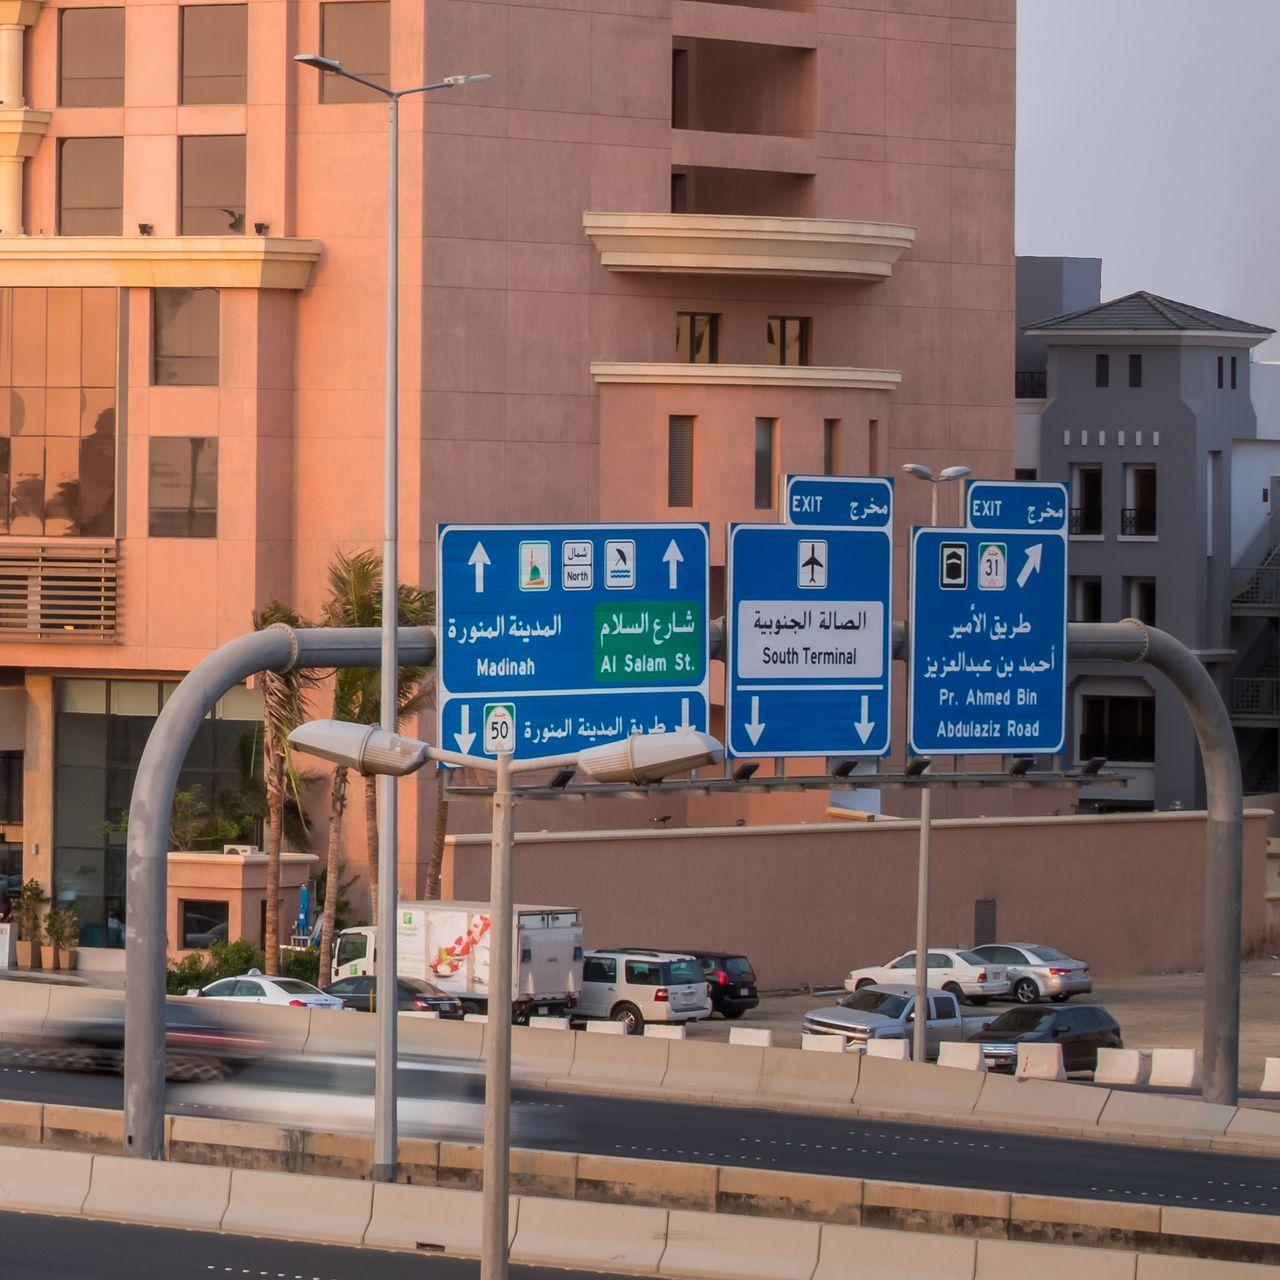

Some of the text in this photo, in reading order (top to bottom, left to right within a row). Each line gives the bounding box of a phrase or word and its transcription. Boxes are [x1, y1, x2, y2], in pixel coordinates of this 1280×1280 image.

[792, 495, 823, 513] EXIT
[849, 497, 888, 521] مخرج
[972, 500, 1002, 517] EXIT
[1027, 501, 1064, 525] مخرج
[567, 546, 588, 560] شمال
[567, 571, 589, 581] North
[985, 558, 998, 577] 31
[448, 614, 562, 645] المدينة المنورة
[600, 609, 695, 647] شارع السلام
[754, 610, 866, 635] الصالة الجنوبية
[949, 603, 1032, 641] طريق الأمير
[600, 653, 695, 673] Al Salam St.
[762, 647, 857, 665] South Terminal
[923, 644, 1055, 678] أحمد بن عبدالعزيز
[476, 658, 535, 677] Madinah
[940, 688, 1037, 706] Pr. Ahmed Bin
[491, 721, 509, 740] 50
[524, 718, 572, 743] المنورة
[577, 716, 623, 742] المدينة
[936, 720, 1040, 738] Abdulaziz Road
